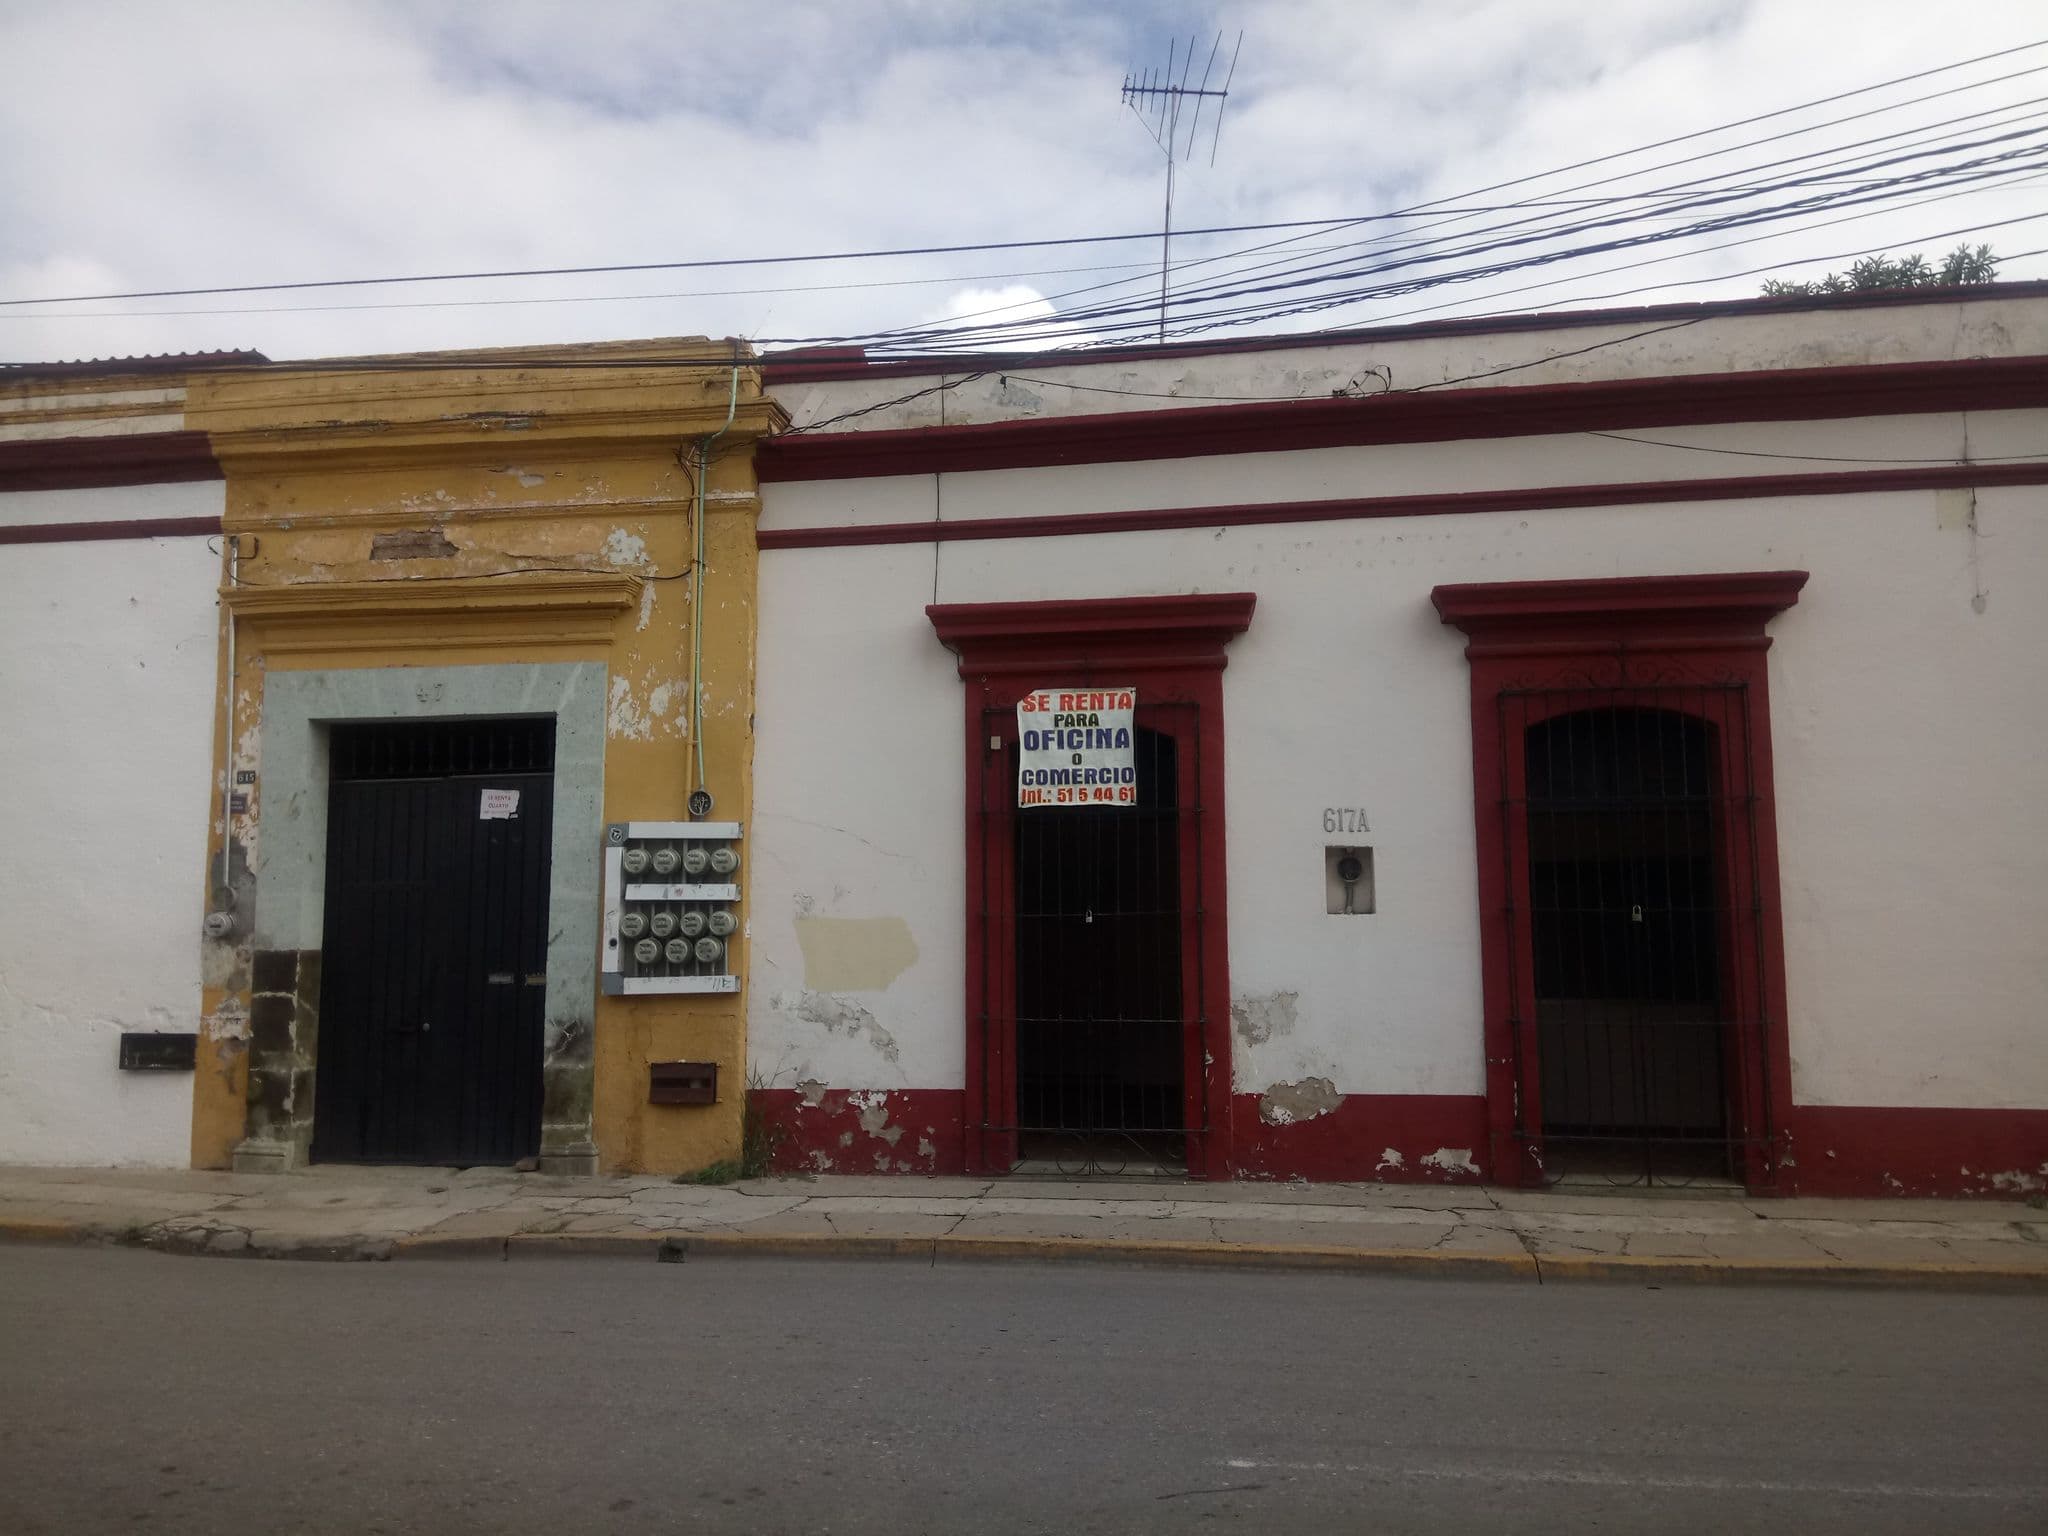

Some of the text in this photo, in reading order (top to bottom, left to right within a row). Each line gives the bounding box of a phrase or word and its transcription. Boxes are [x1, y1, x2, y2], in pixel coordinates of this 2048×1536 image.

[1022, 692, 1133, 712] SE RENTA
[1054, 713, 1100, 727] PARA
[1024, 728, 1130, 751] OFICINA
[1072, 753, 1082, 765] O
[1021, 767, 1135, 786] COMERCIO
[1021, 787, 1135, 804] Inf.: 51 5 44 61
[1323, 808, 1371, 833] 617A
